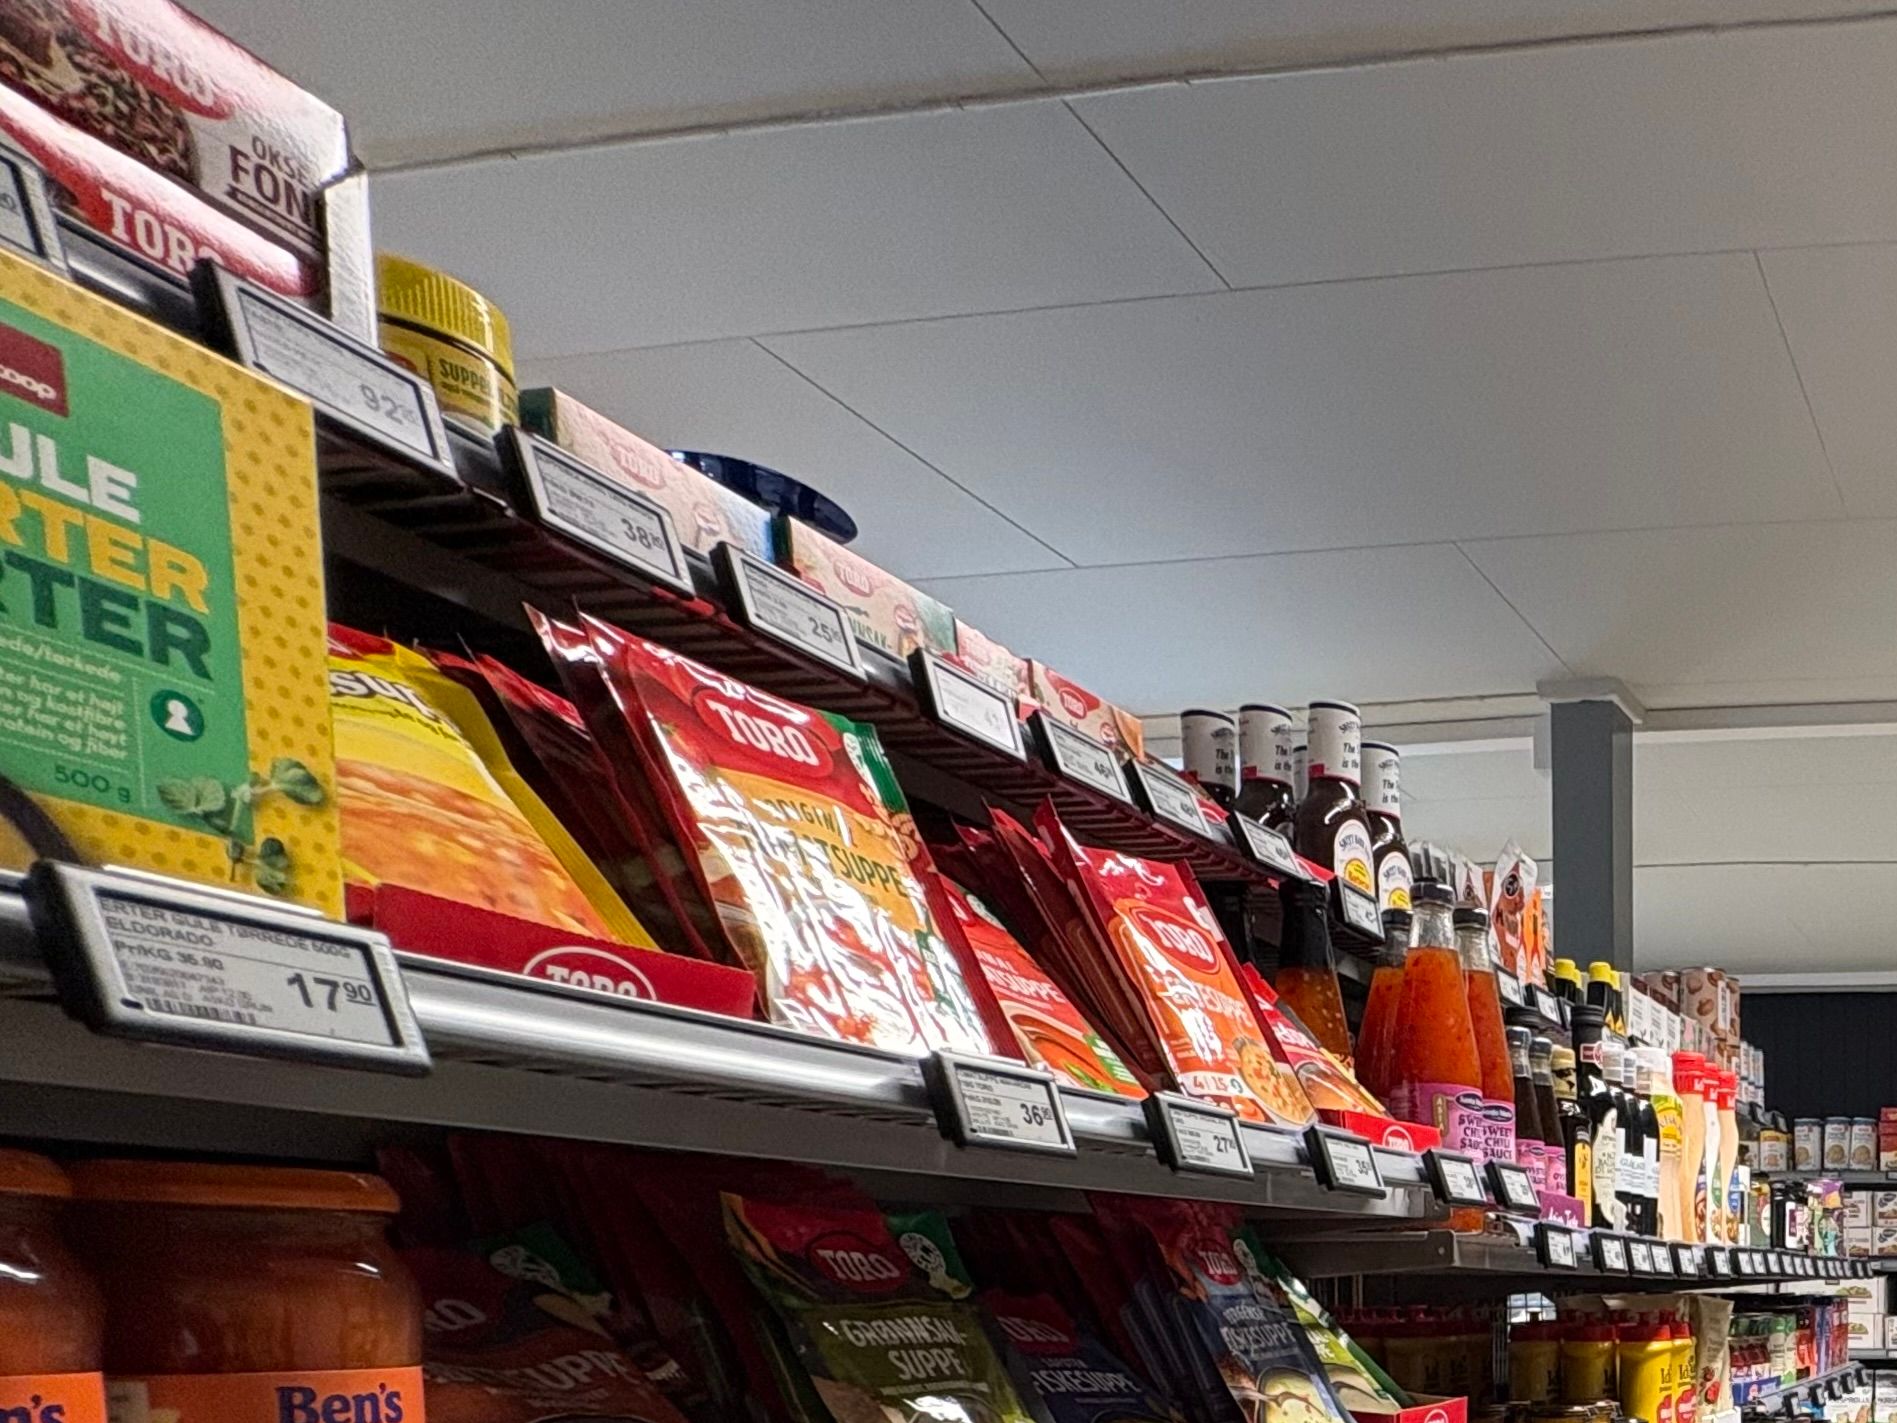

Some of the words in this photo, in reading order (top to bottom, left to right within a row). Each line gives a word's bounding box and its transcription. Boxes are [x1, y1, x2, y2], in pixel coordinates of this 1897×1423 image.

[102, 190, 223, 270] TOR
[0, 550, 213, 681] TER
[706, 699, 820, 767] TORO
[55, 763, 110, 794] 500
[118, 787, 131, 804] g
[101, 899, 167, 923] ERTER
[171, 911, 223, 934] GULE
[105, 916, 214, 948] ELDORADO
[816, 1246, 900, 1282] TORO
[888, 1346, 963, 1381] SUPPE
